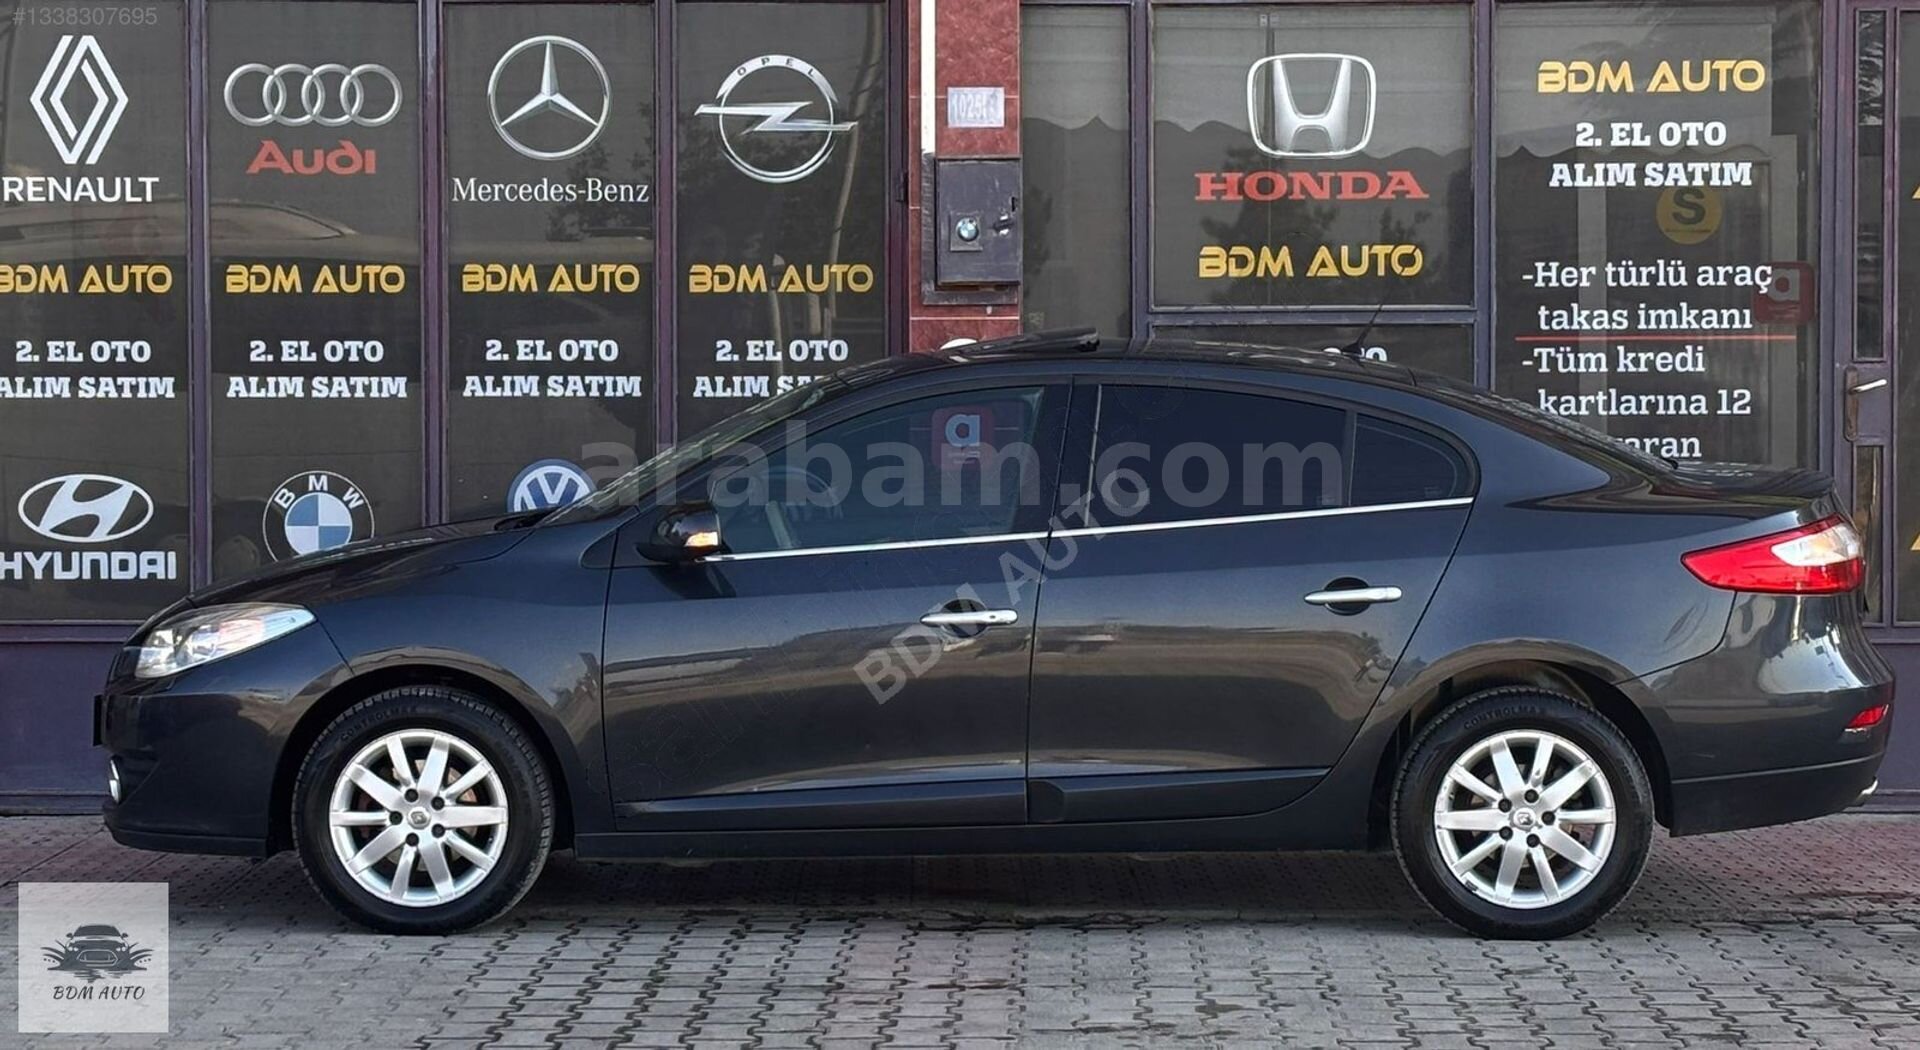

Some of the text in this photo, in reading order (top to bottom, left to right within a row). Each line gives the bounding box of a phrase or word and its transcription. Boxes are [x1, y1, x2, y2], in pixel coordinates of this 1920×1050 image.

[737, 56, 815, 77] OPEL
[1537, 59, 1766, 93] BDM AUTO
[1575, 121, 1727, 147] 2. EL OTO
[246, 140, 377, 175] Audi
[1194, 170, 1430, 202] HONDA
[1548, 161, 1753, 188] ALIM SATIM
[2, 176, 160, 203] RENAULT
[452, 177, 649, 203] Mercedes-Benz
[1198, 243, 1424, 279] BDM AUTO
[0, 263, 173, 294] BDM AUTO
[225, 263, 405, 294] BDM AUTO
[461, 262, 640, 293] BDM AUTO
[688, 263, 874, 294] BDM AUTO
[1522, 259, 1773, 294] -Her türlü araç
[1537, 302, 1629, 331] takas
[1637, 301, 1753, 330] imkanı
[15, 340, 152, 363] 2. EL OTO
[249, 340, 384, 363] 2. EL OTO
[485, 339, 619, 362] 2. EL OTO
[716, 339, 849, 362] 2. EL OTO
[1522, 344, 1706, 373] -Tüm kredi
[0, 376, 176, 399] ALIM SATIM
[226, 375, 408, 398] ALIM SATIM
[462, 375, 642, 397] ALIM SATIM
[692, 375, 770, 398] ALIM
[1537, 388, 1751, 416] kartlarına 12
[275, 475, 363, 510] BMW
[0, 551, 177, 580] HYUNDAI
